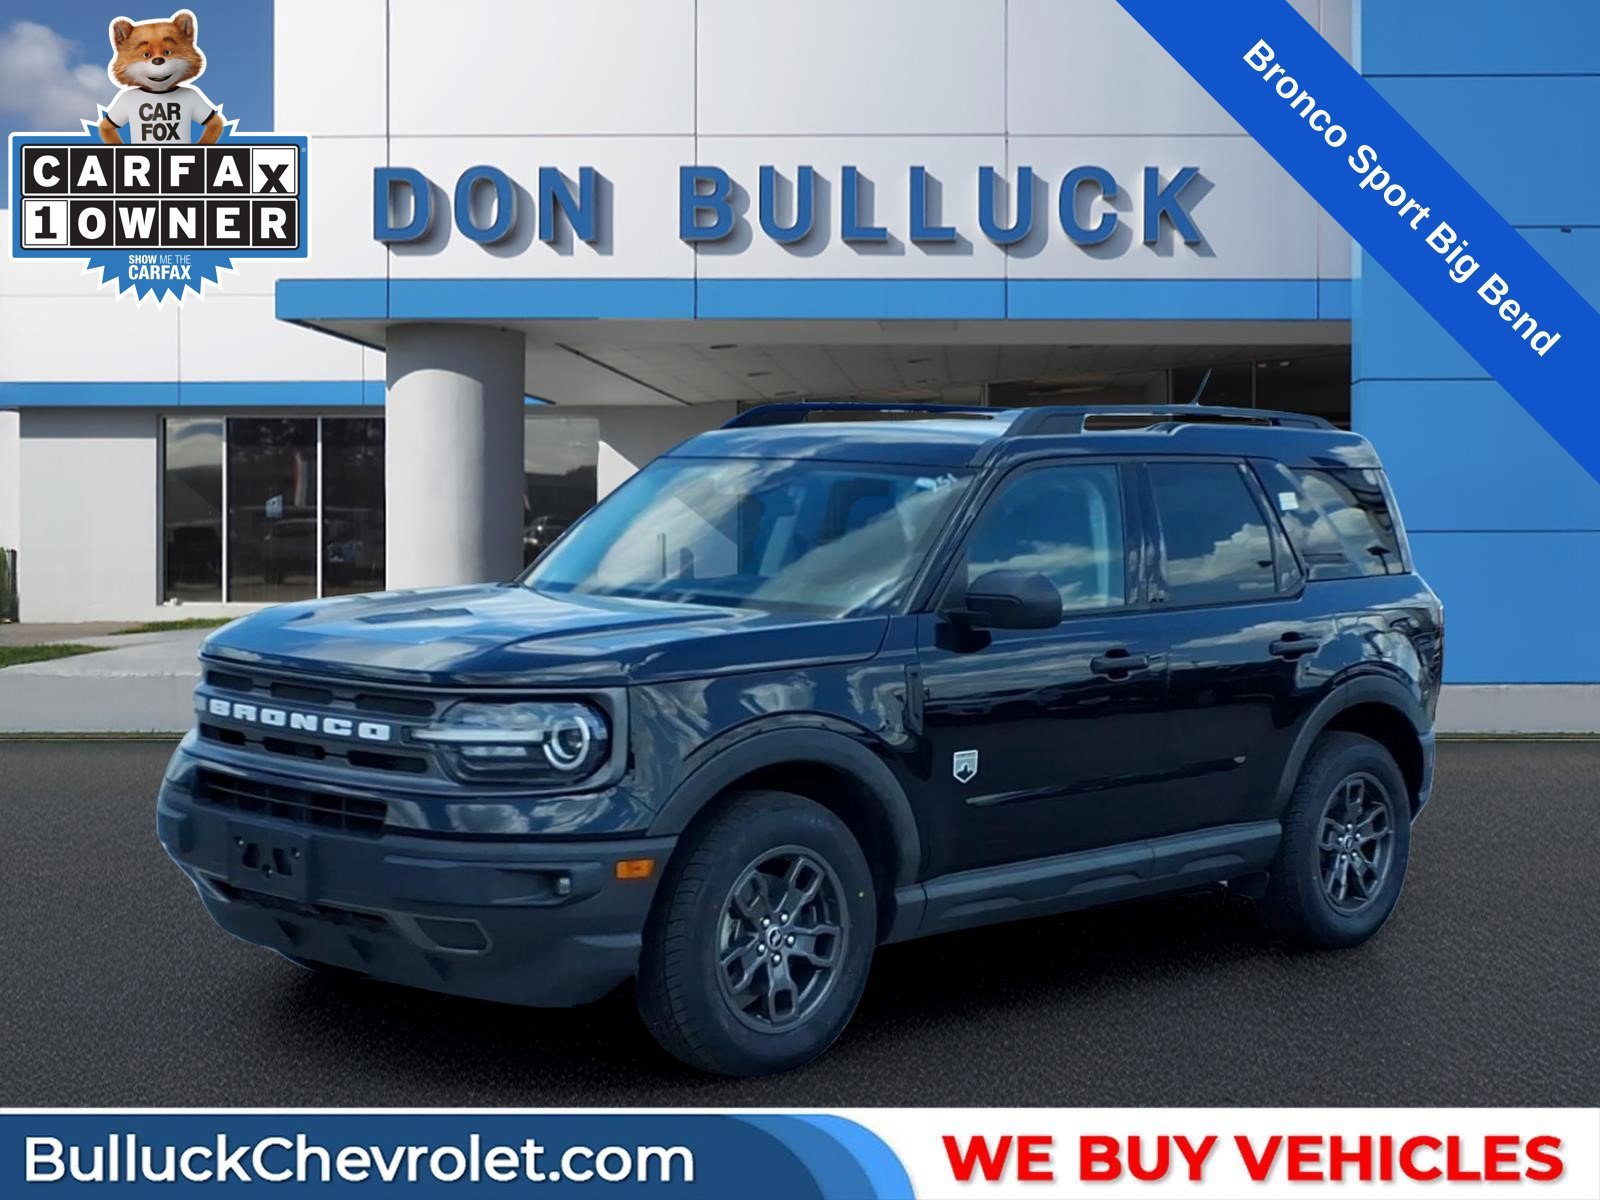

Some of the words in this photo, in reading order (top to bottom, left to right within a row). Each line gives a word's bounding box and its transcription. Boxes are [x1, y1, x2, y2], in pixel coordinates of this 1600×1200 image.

[373, 165, 596, 244] DON
[679, 165, 1203, 245] BULLUCK
[207, 697, 391, 742] BRONCO
